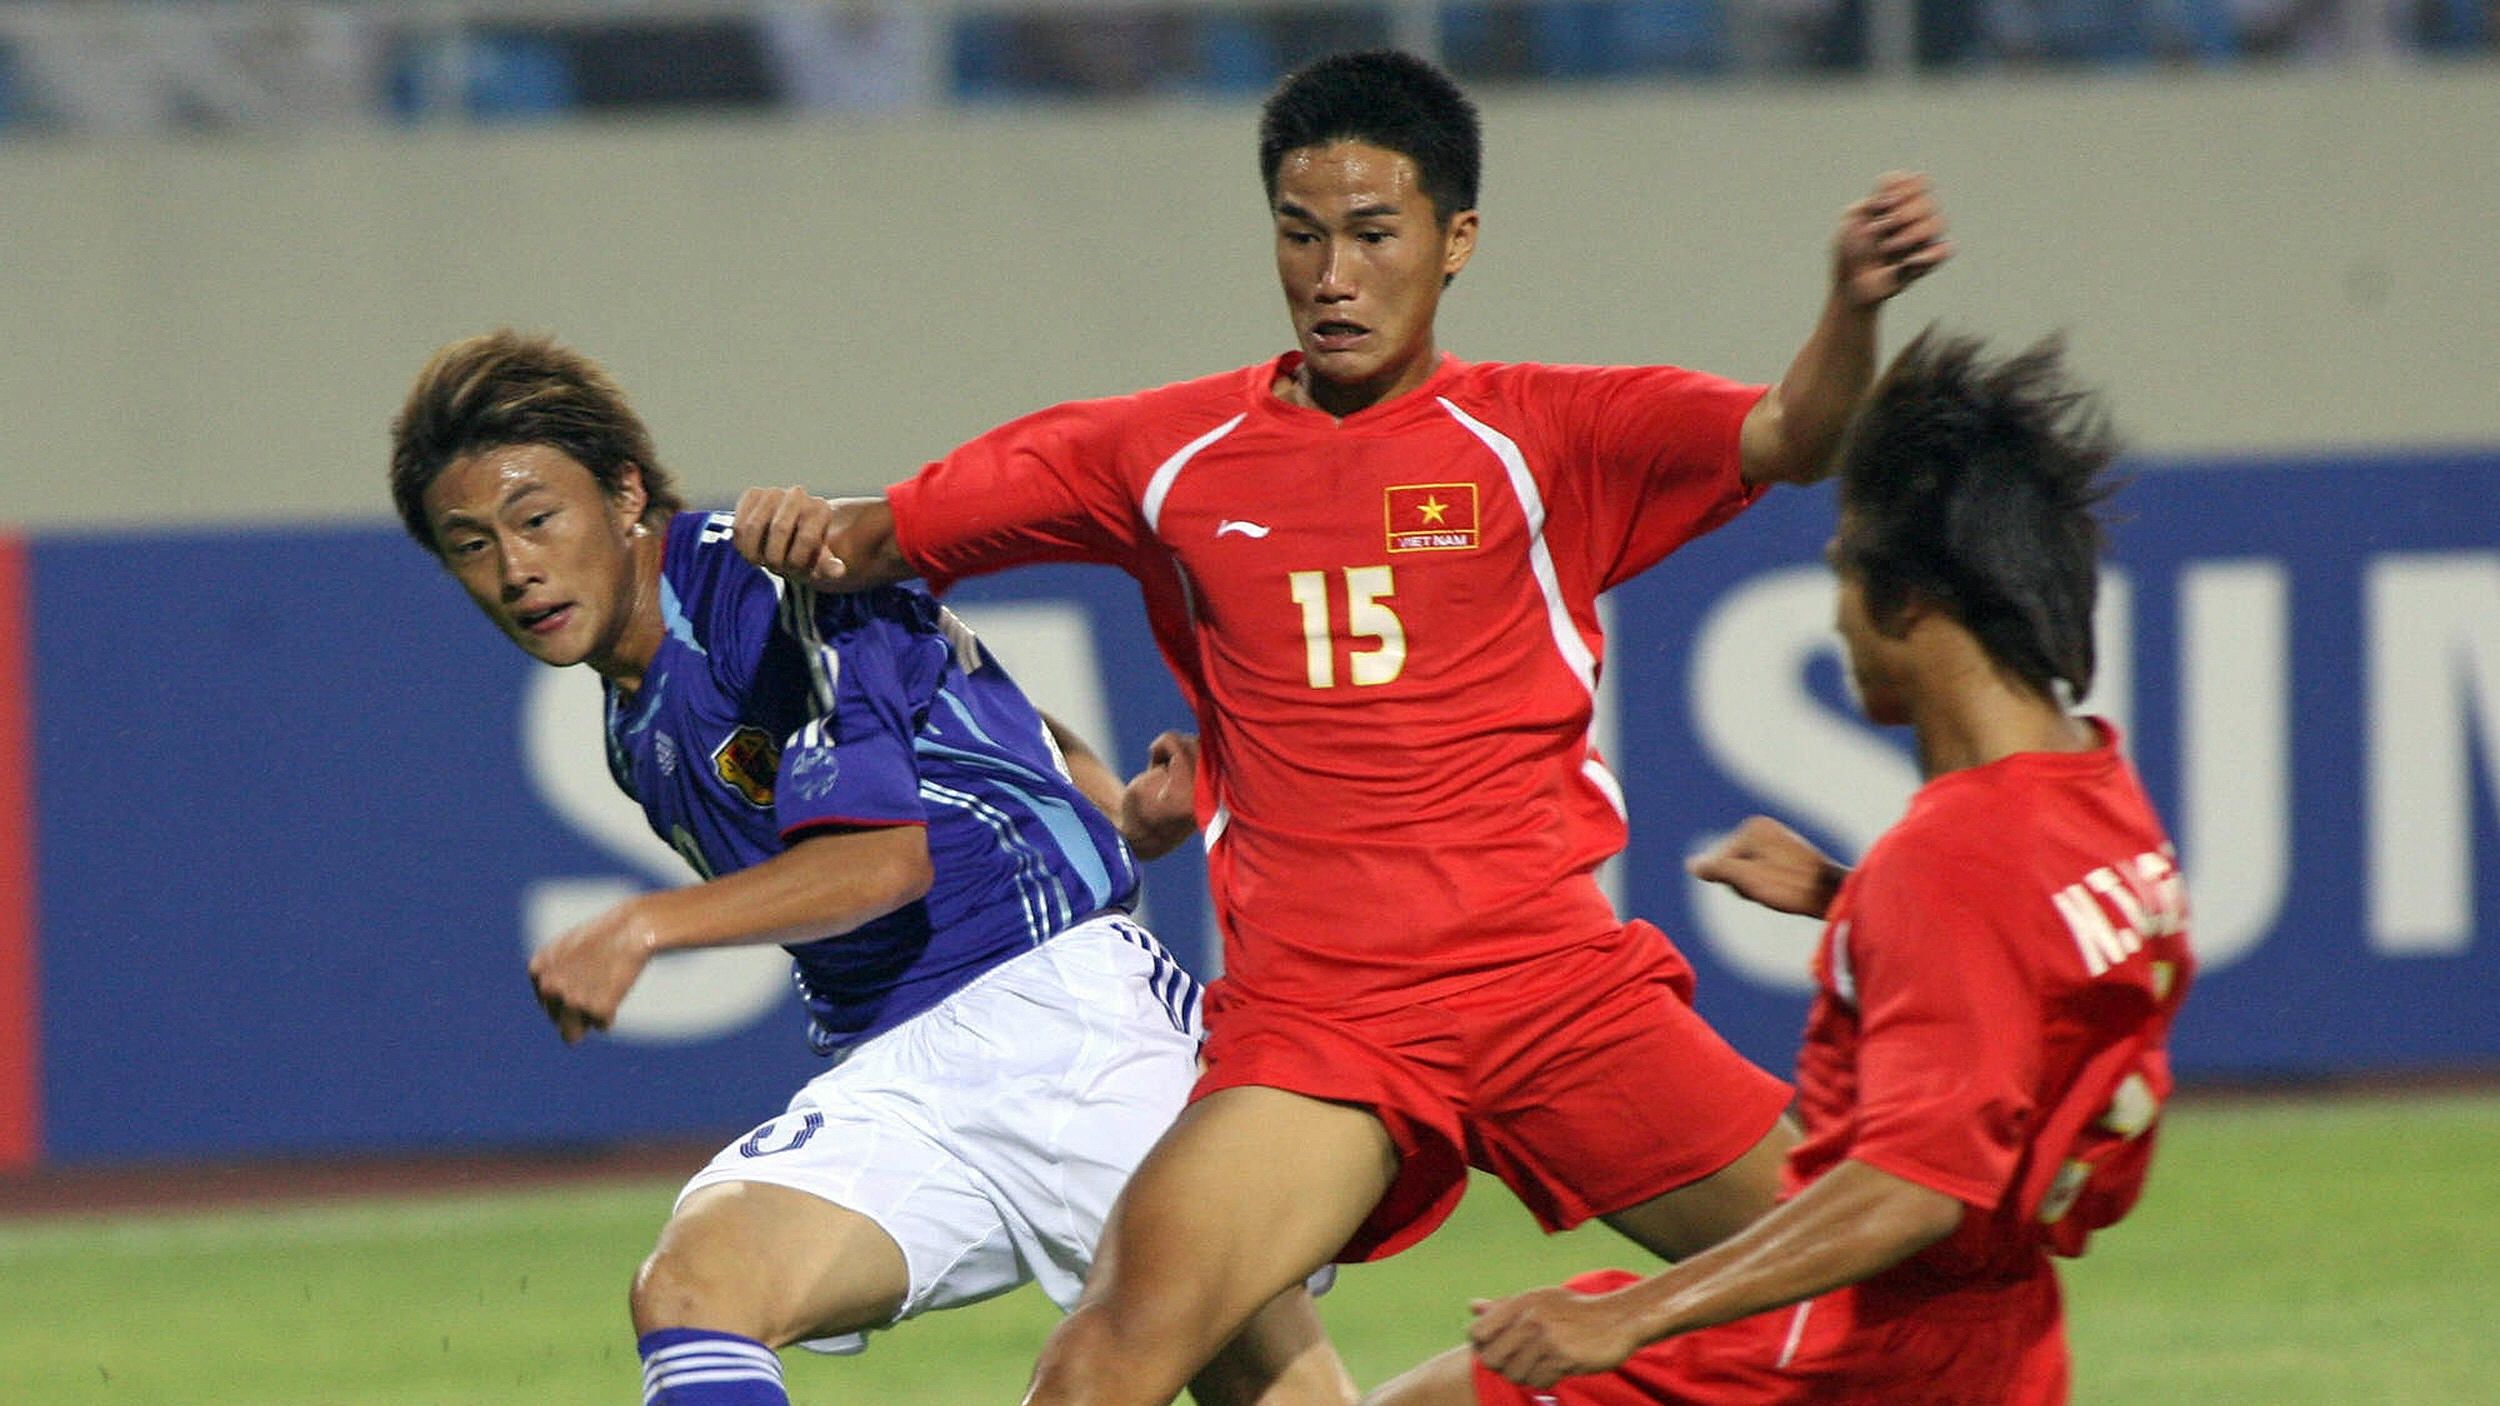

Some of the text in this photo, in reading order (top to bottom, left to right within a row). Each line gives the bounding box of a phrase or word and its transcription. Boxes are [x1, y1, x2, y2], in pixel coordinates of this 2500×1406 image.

[1396, 534, 1468, 548] VIET NAM
[1288, 565, 1408, 689] 15
